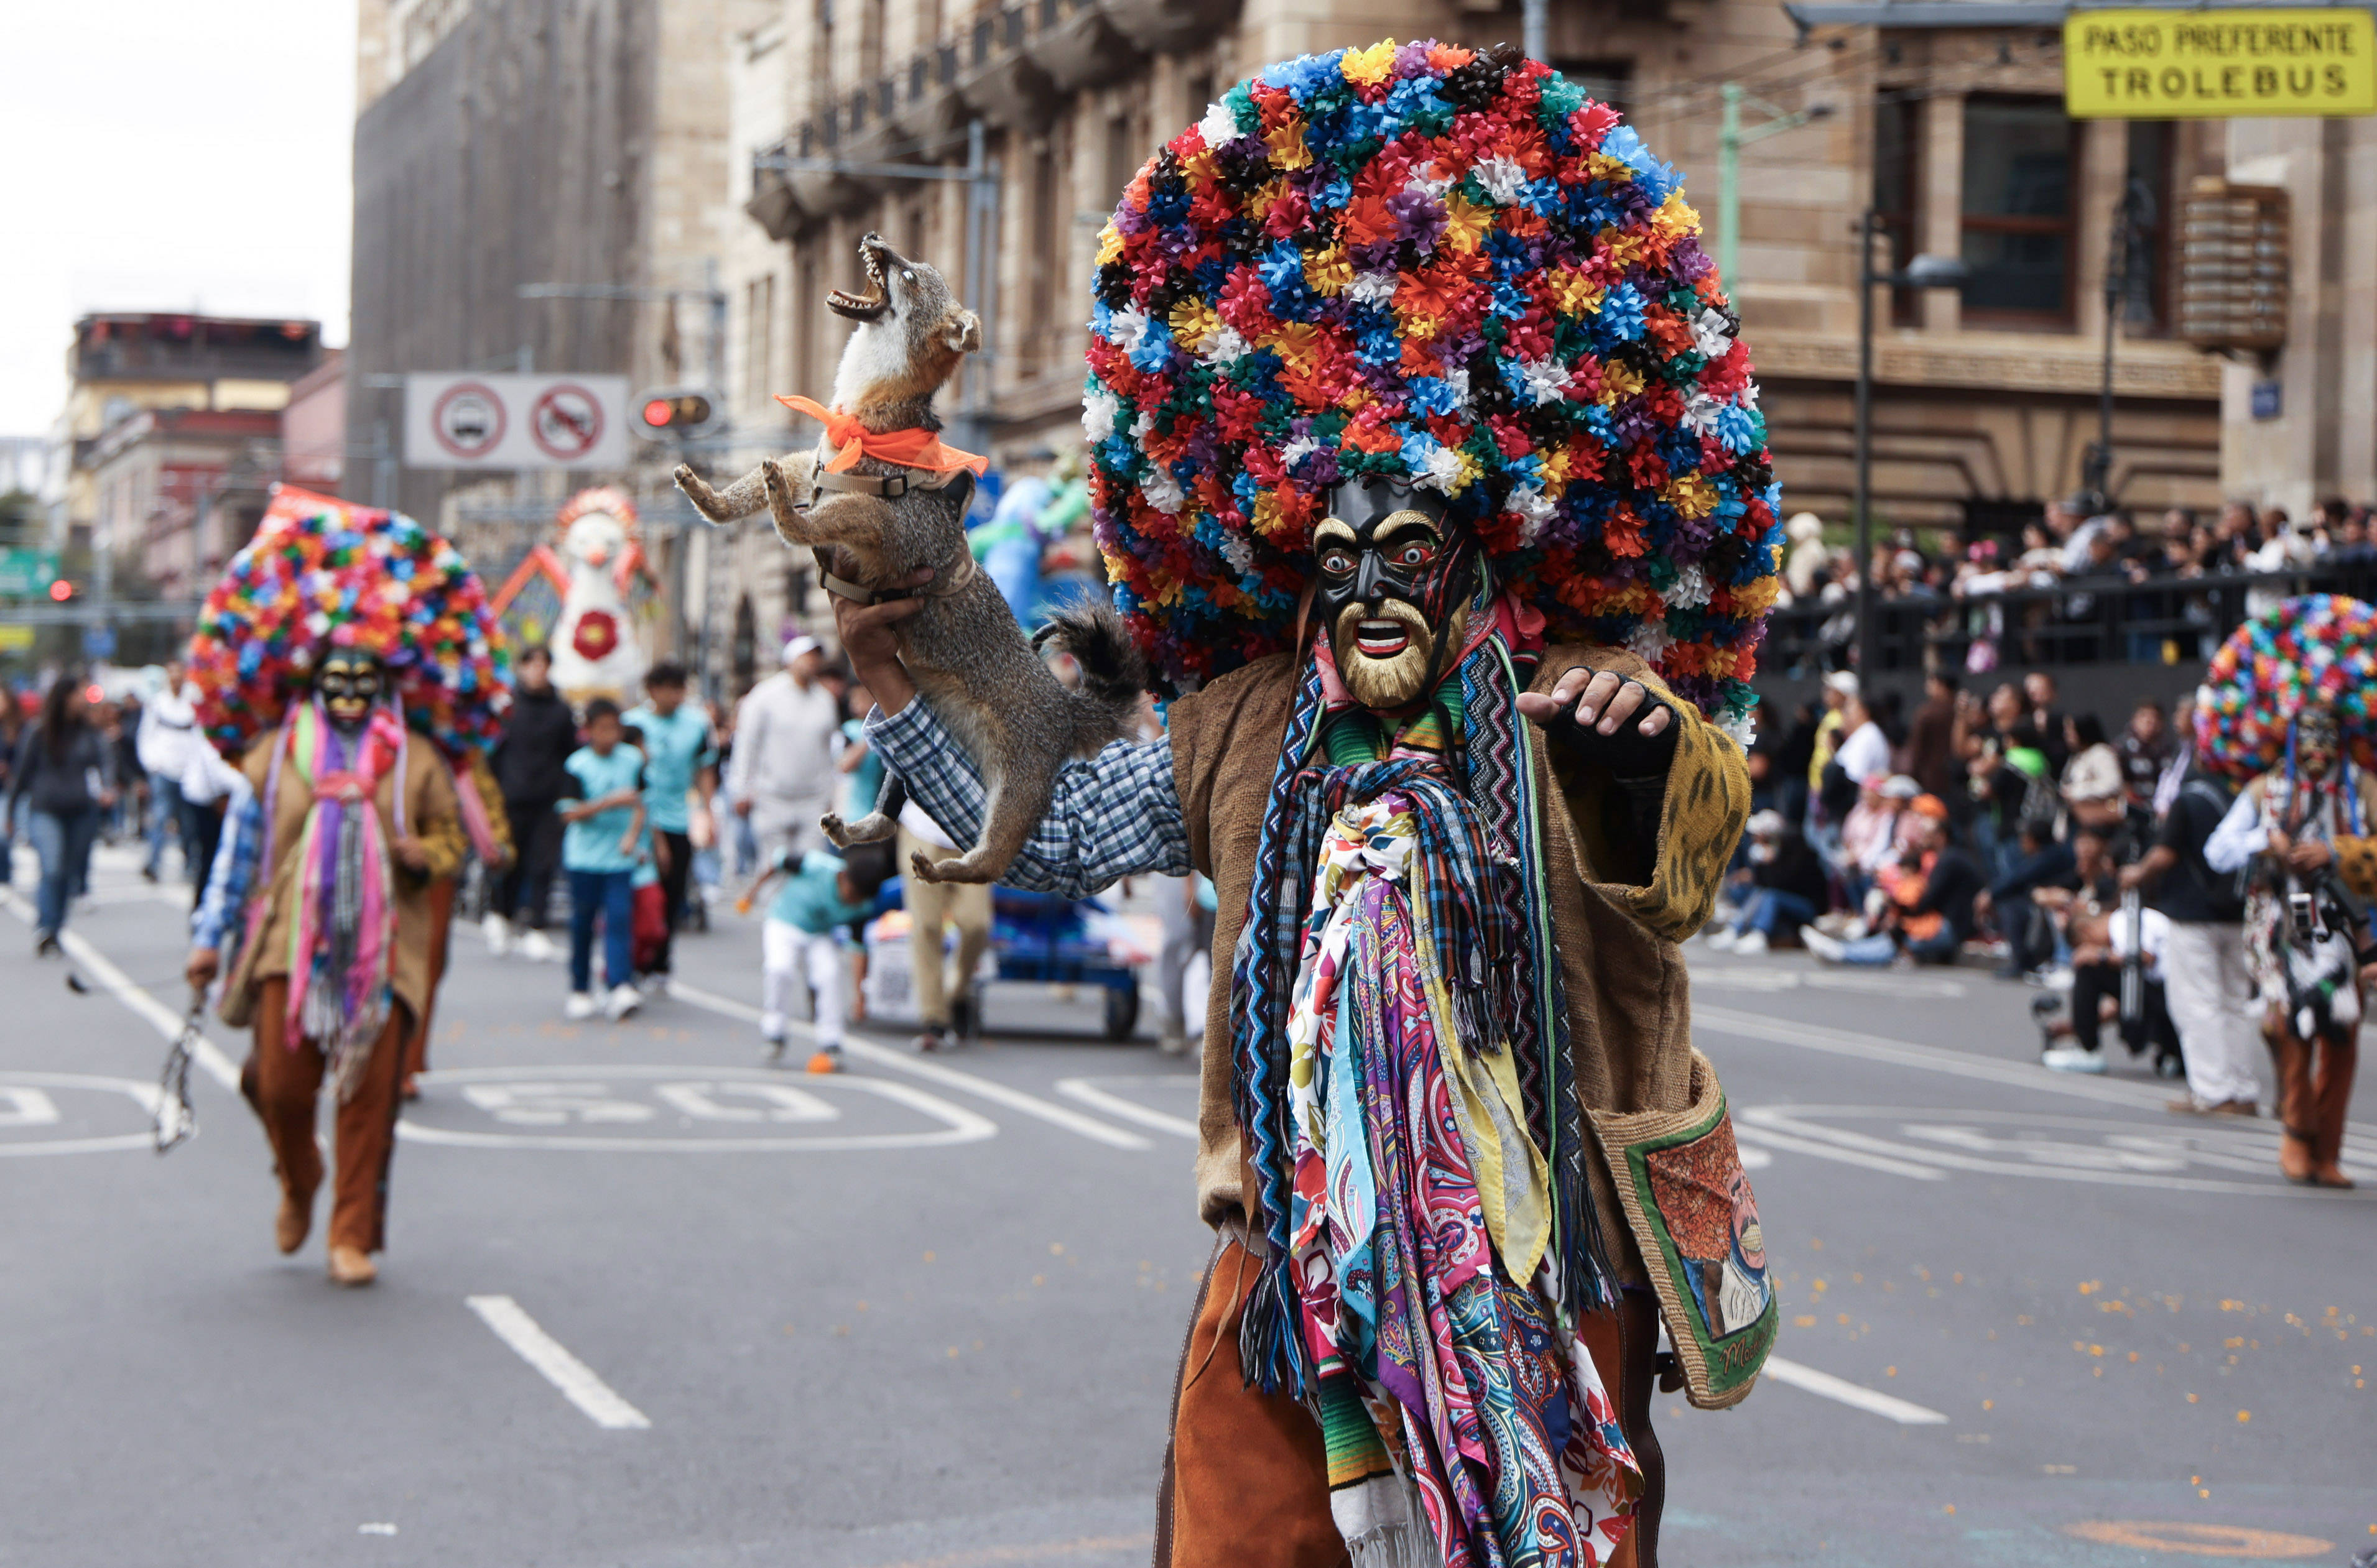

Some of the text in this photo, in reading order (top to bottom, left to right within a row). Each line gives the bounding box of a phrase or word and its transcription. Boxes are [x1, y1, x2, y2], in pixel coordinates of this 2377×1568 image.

[2084, 23, 2357, 57] PASO PREFERENTE
[2100, 64, 2348, 98] TROLEBUS
